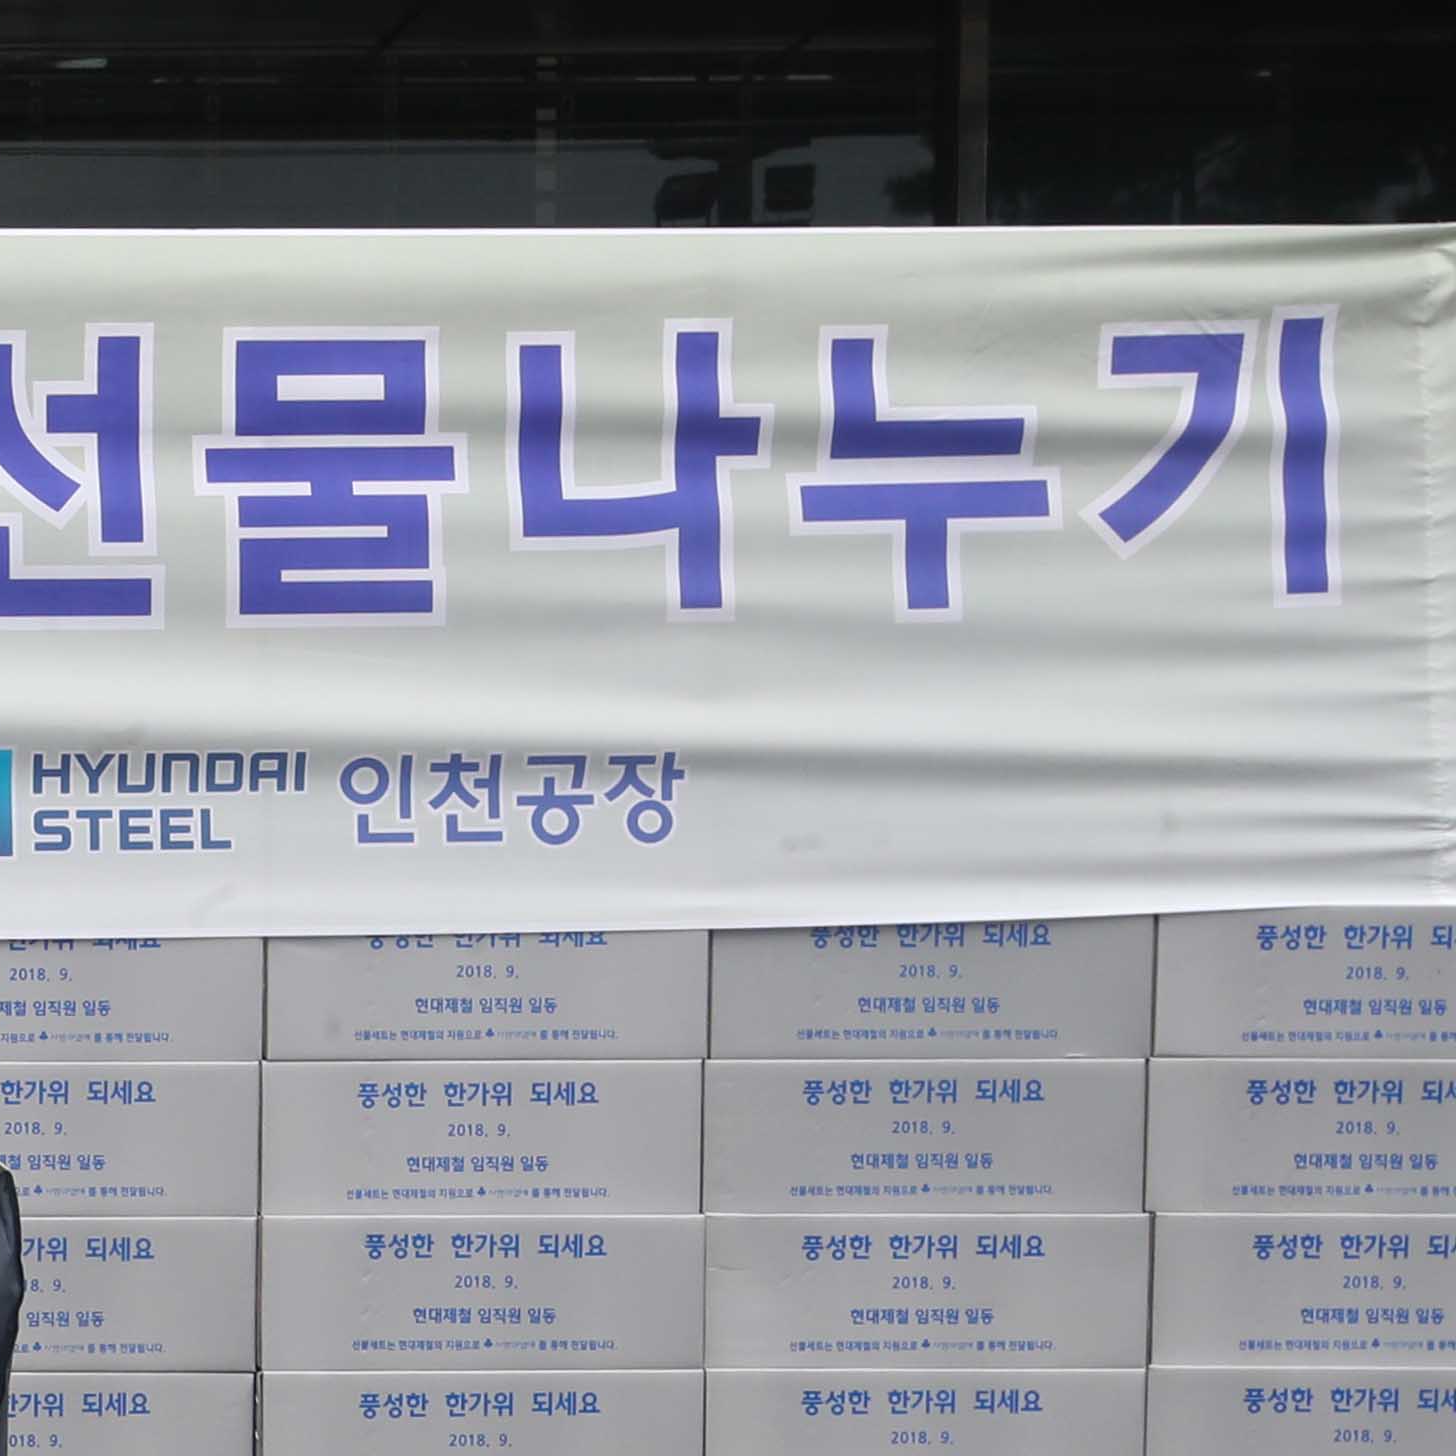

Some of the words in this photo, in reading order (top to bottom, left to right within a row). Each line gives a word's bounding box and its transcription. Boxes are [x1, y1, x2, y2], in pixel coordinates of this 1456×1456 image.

[31, 750, 308, 794] HYUNDAI
[338, 750, 687, 846] 인천공장
[32, 808, 233, 852] STEEL
[364, 1233, 434, 1259] 풍성한
[451, 1232, 520, 1259] 한가위
[538, 1232, 607, 1258] 되세요
[413, 1308, 472, 1324] 현대제철
[478, 1307, 521, 1324] 임직원
[528, 1307, 556, 1324] 일동
[801, 1389, 871, 1416] 풍성한
[888, 1388, 956, 1415] 한가위
[974, 1387, 1043, 1414] 되세요
